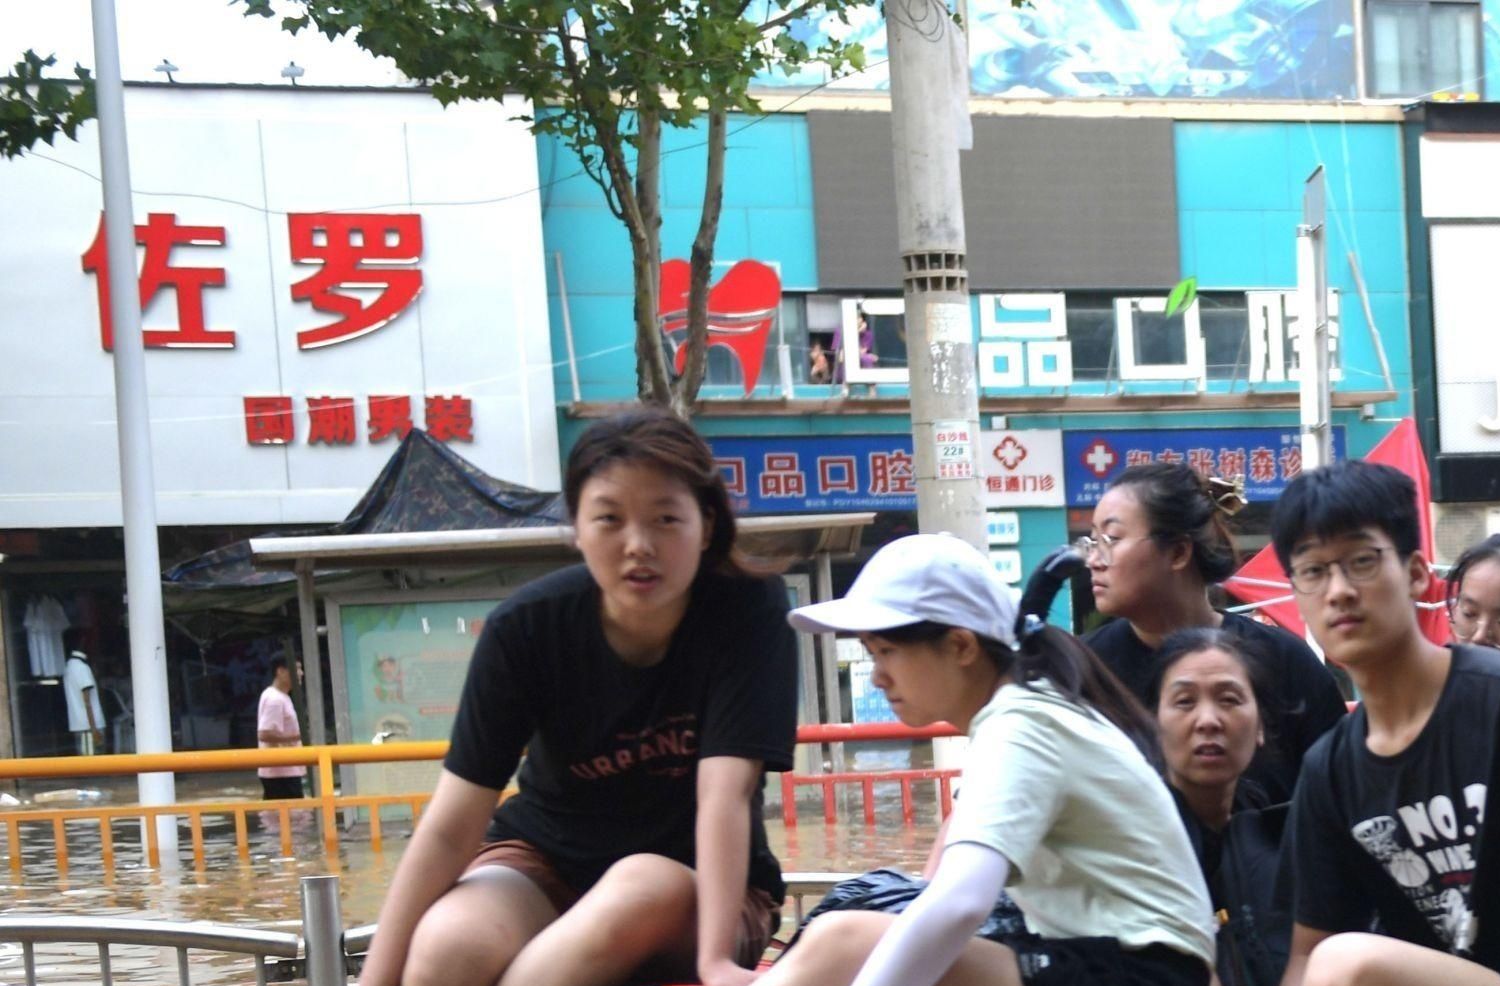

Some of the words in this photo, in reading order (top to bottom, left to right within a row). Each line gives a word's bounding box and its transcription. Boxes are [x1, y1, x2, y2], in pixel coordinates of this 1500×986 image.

[81, 210, 424, 352] 佐罗
[243, 395, 474, 446] 国潮男装
[985, 474, 1055, 493] 恒通门诊
